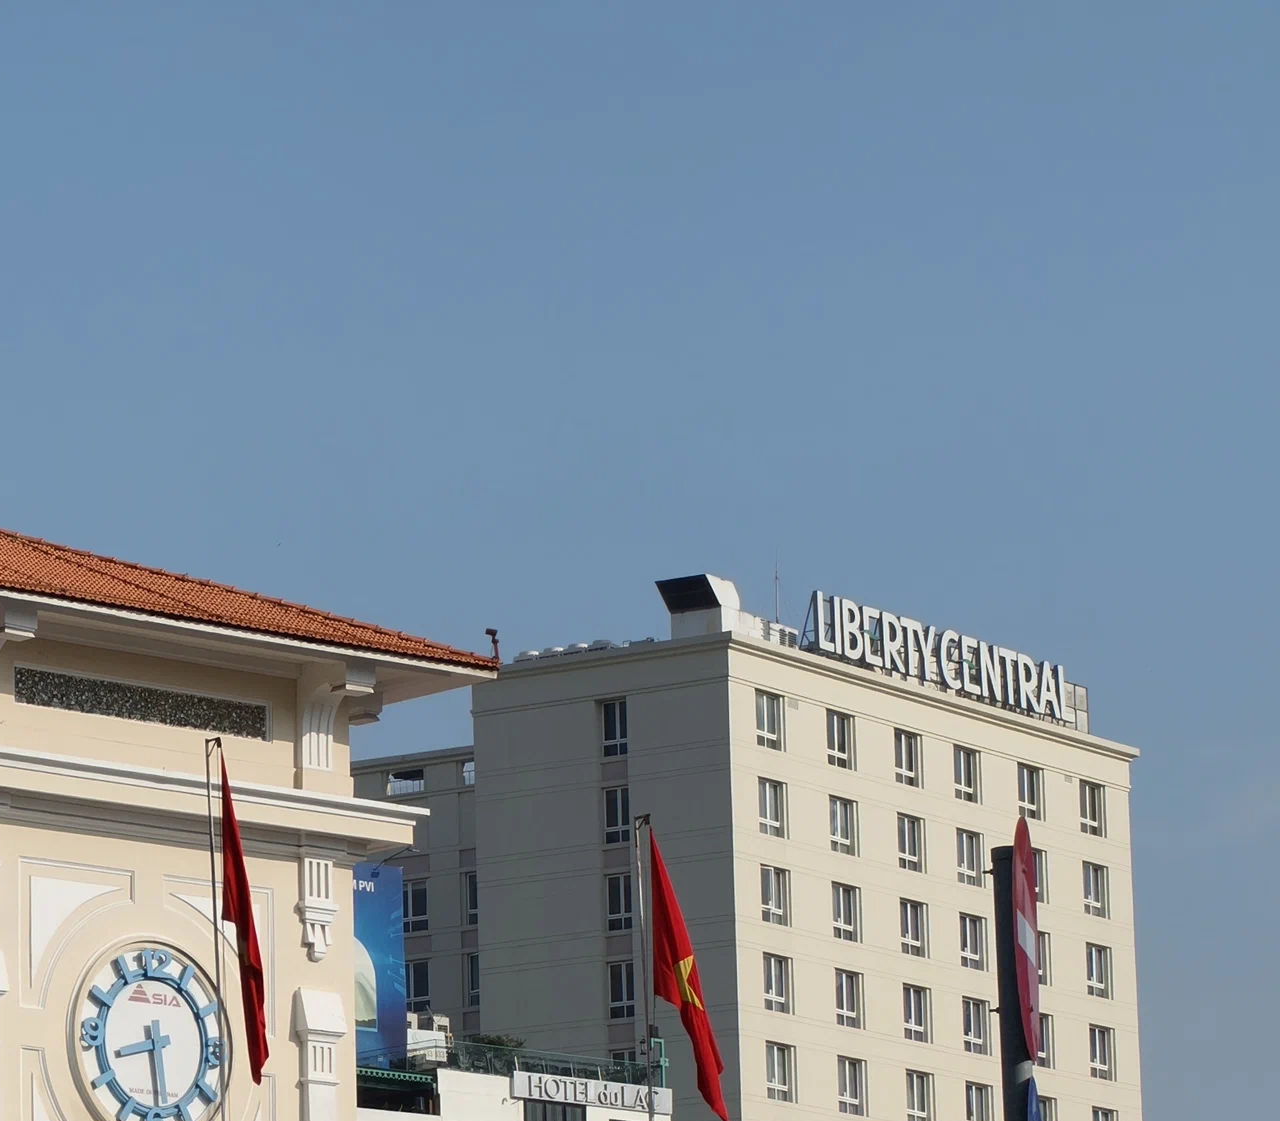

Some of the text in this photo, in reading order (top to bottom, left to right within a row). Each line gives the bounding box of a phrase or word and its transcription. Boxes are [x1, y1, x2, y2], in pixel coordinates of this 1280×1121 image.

[813, 590, 1075, 723] LIBERTY CENTRAL
[358, 879, 375, 893] PVI
[528, 1074, 596, 1104] HOTEL
[598, 1084, 619, 1106] du
